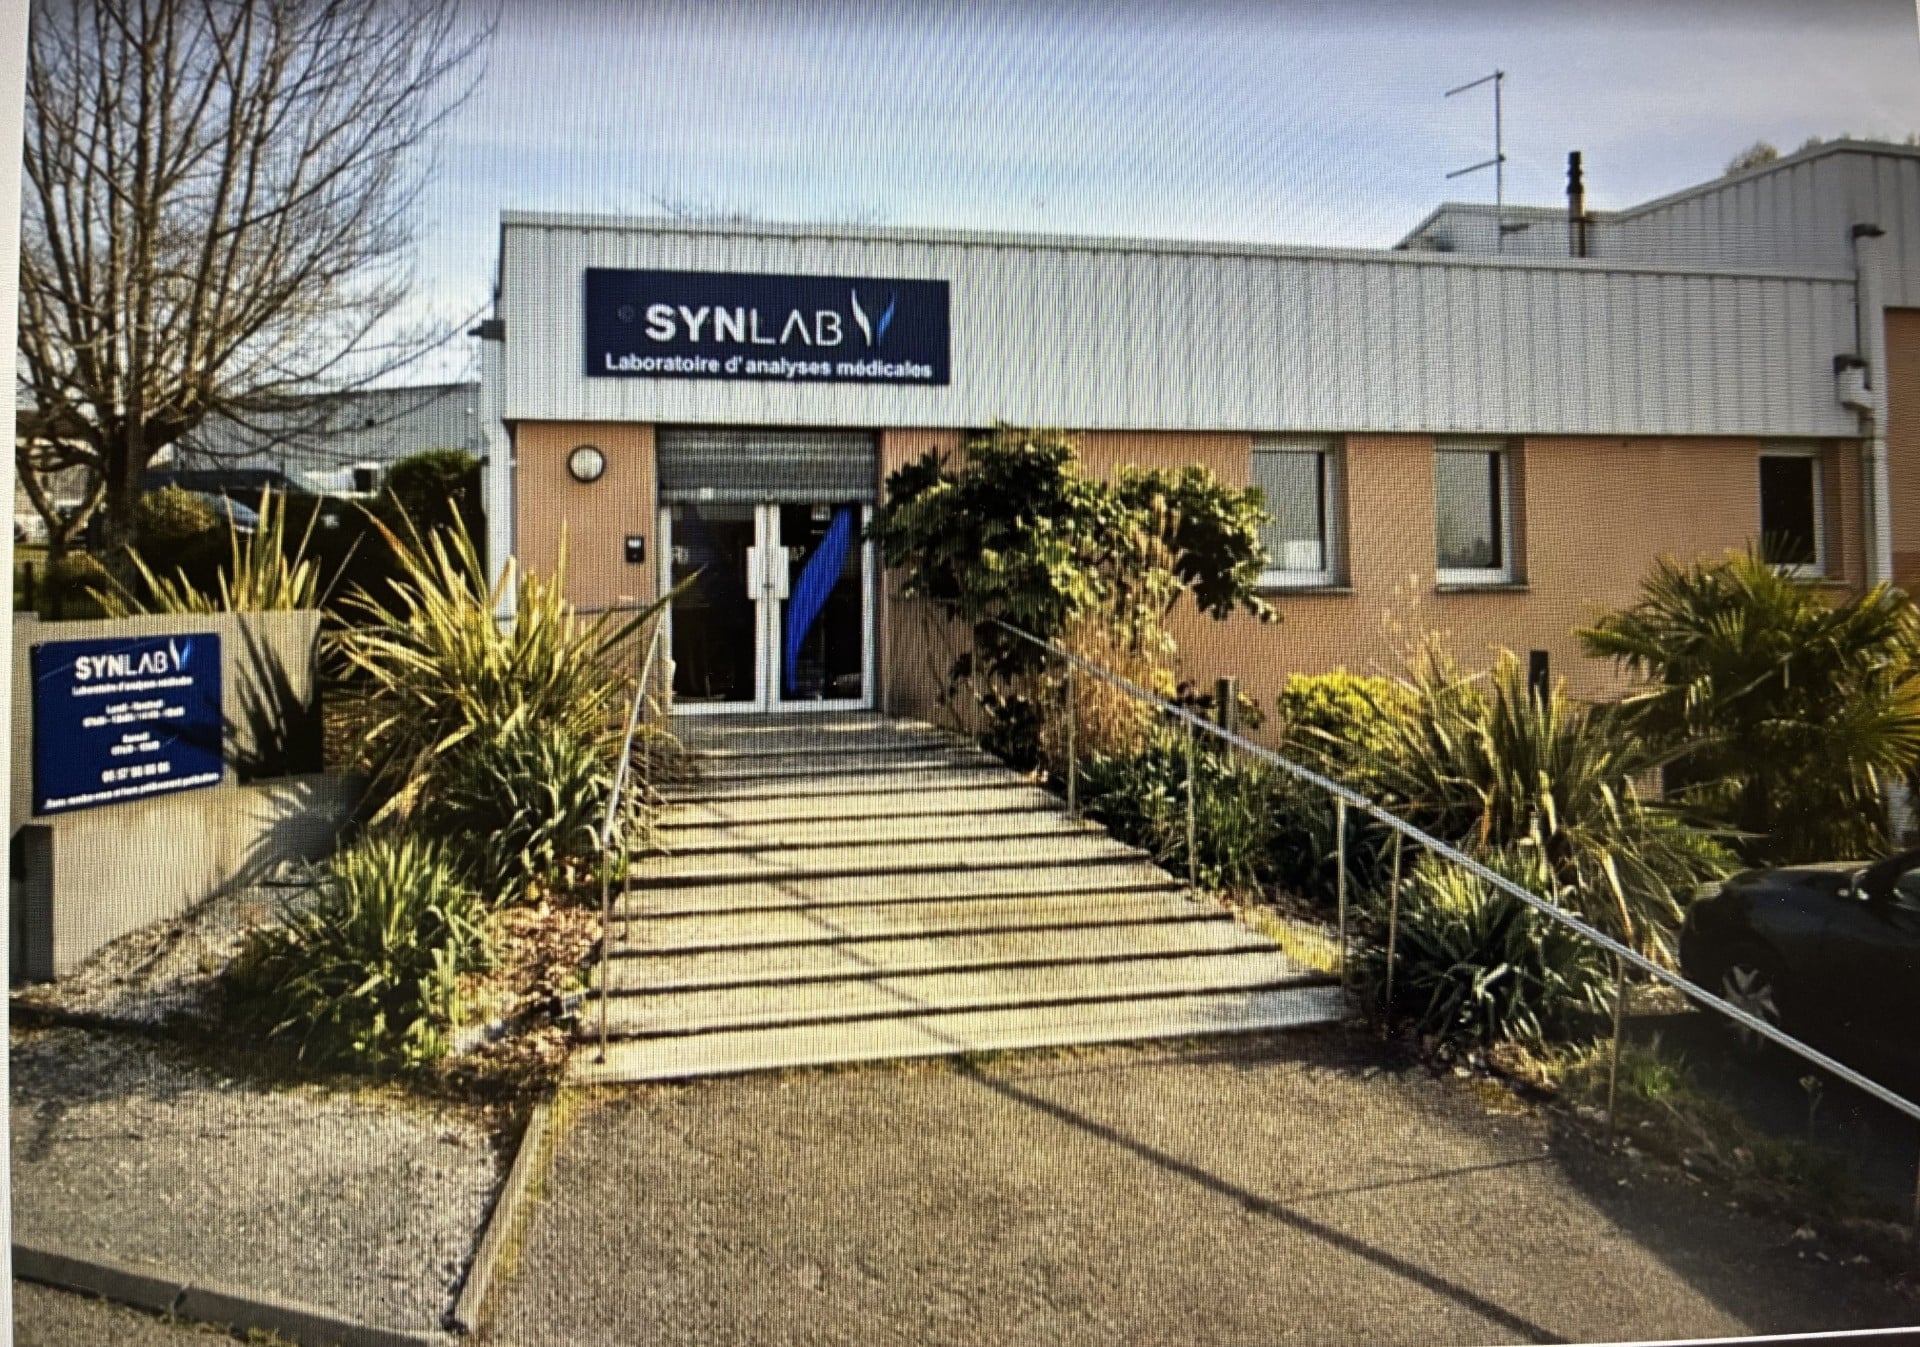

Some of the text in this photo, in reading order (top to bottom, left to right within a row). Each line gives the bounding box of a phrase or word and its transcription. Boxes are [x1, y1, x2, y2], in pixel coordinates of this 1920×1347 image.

[644, 303, 843, 347] SYNLAB
[605, 352, 720, 373] Laboratoire
[836, 356, 933, 378] médicales
[75, 651, 168, 680] SYNLAB
